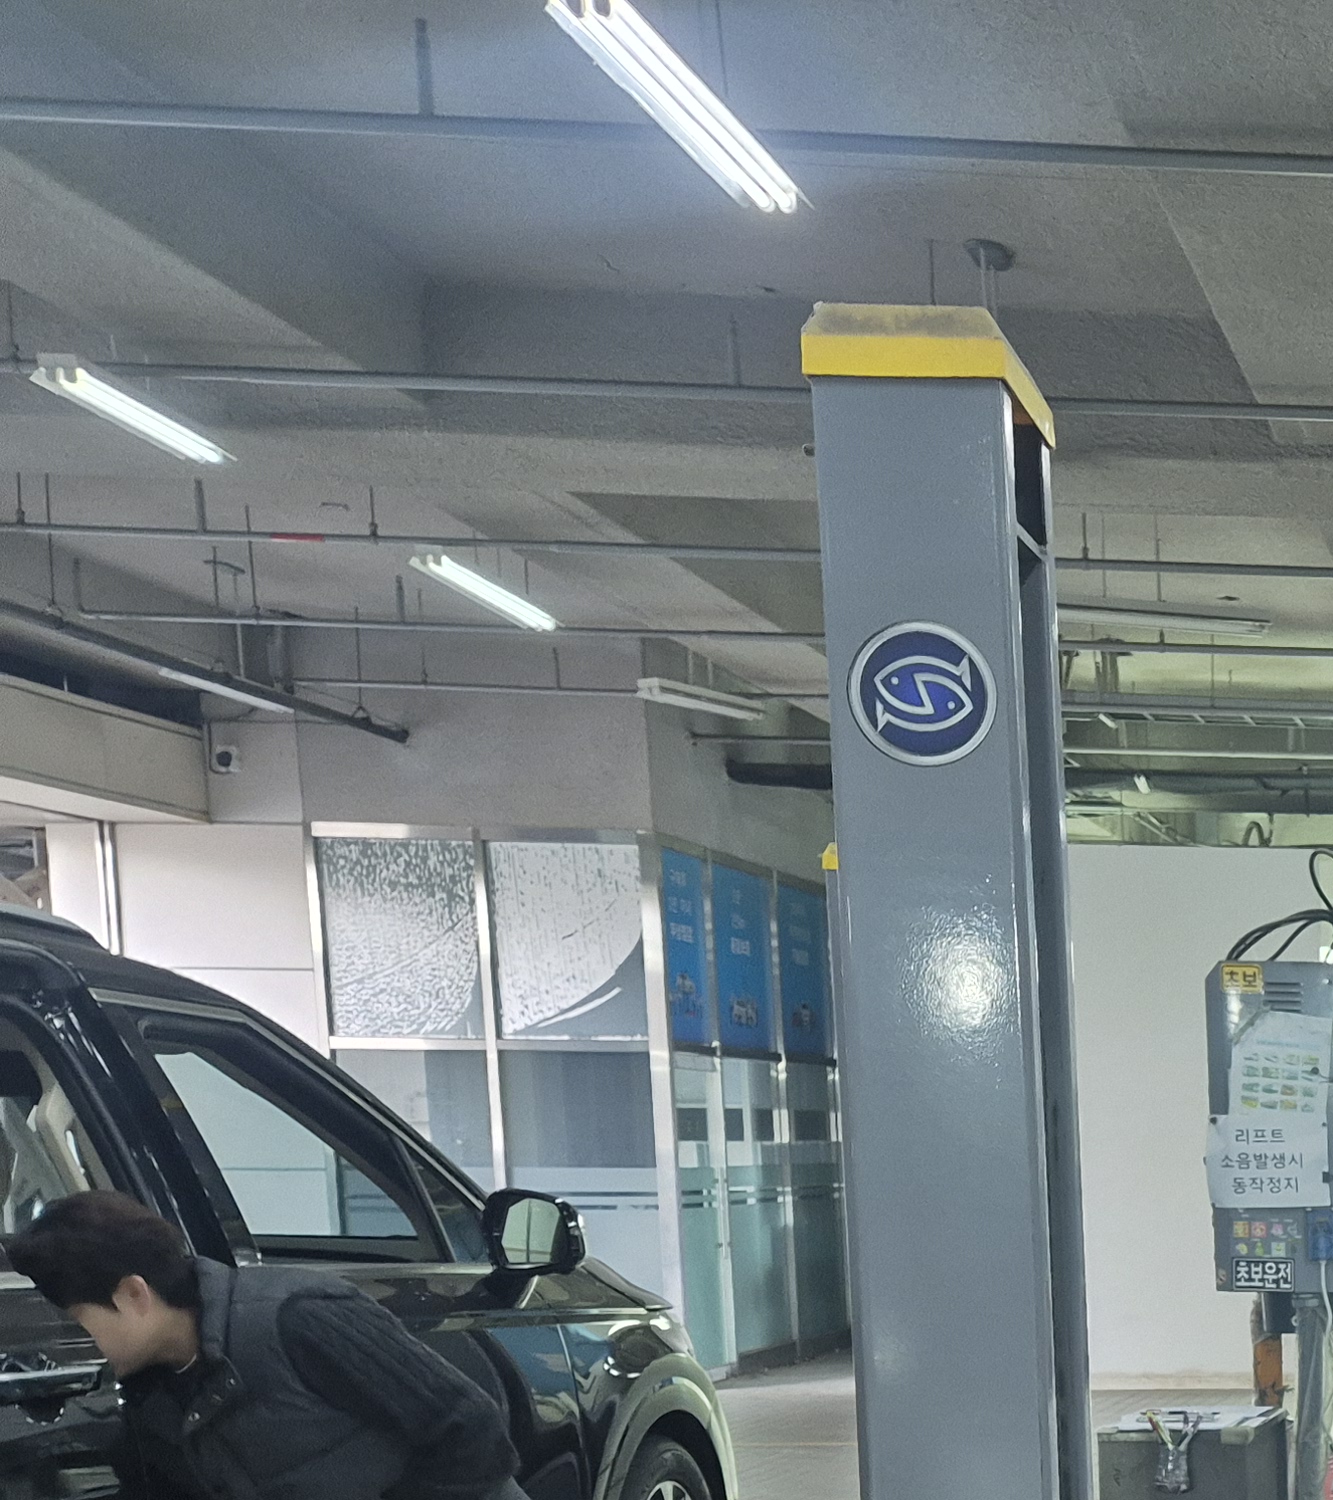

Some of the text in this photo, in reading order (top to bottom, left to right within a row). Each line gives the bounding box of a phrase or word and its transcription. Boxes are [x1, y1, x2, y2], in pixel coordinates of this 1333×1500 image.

[1235, 1128, 1286, 1144] 리프트
[1220, 1152, 1304, 1170] 소음발생시
[1231, 1176, 1300, 1195] 동작정지
[1235, 1260, 1292, 1289] 초보운전
